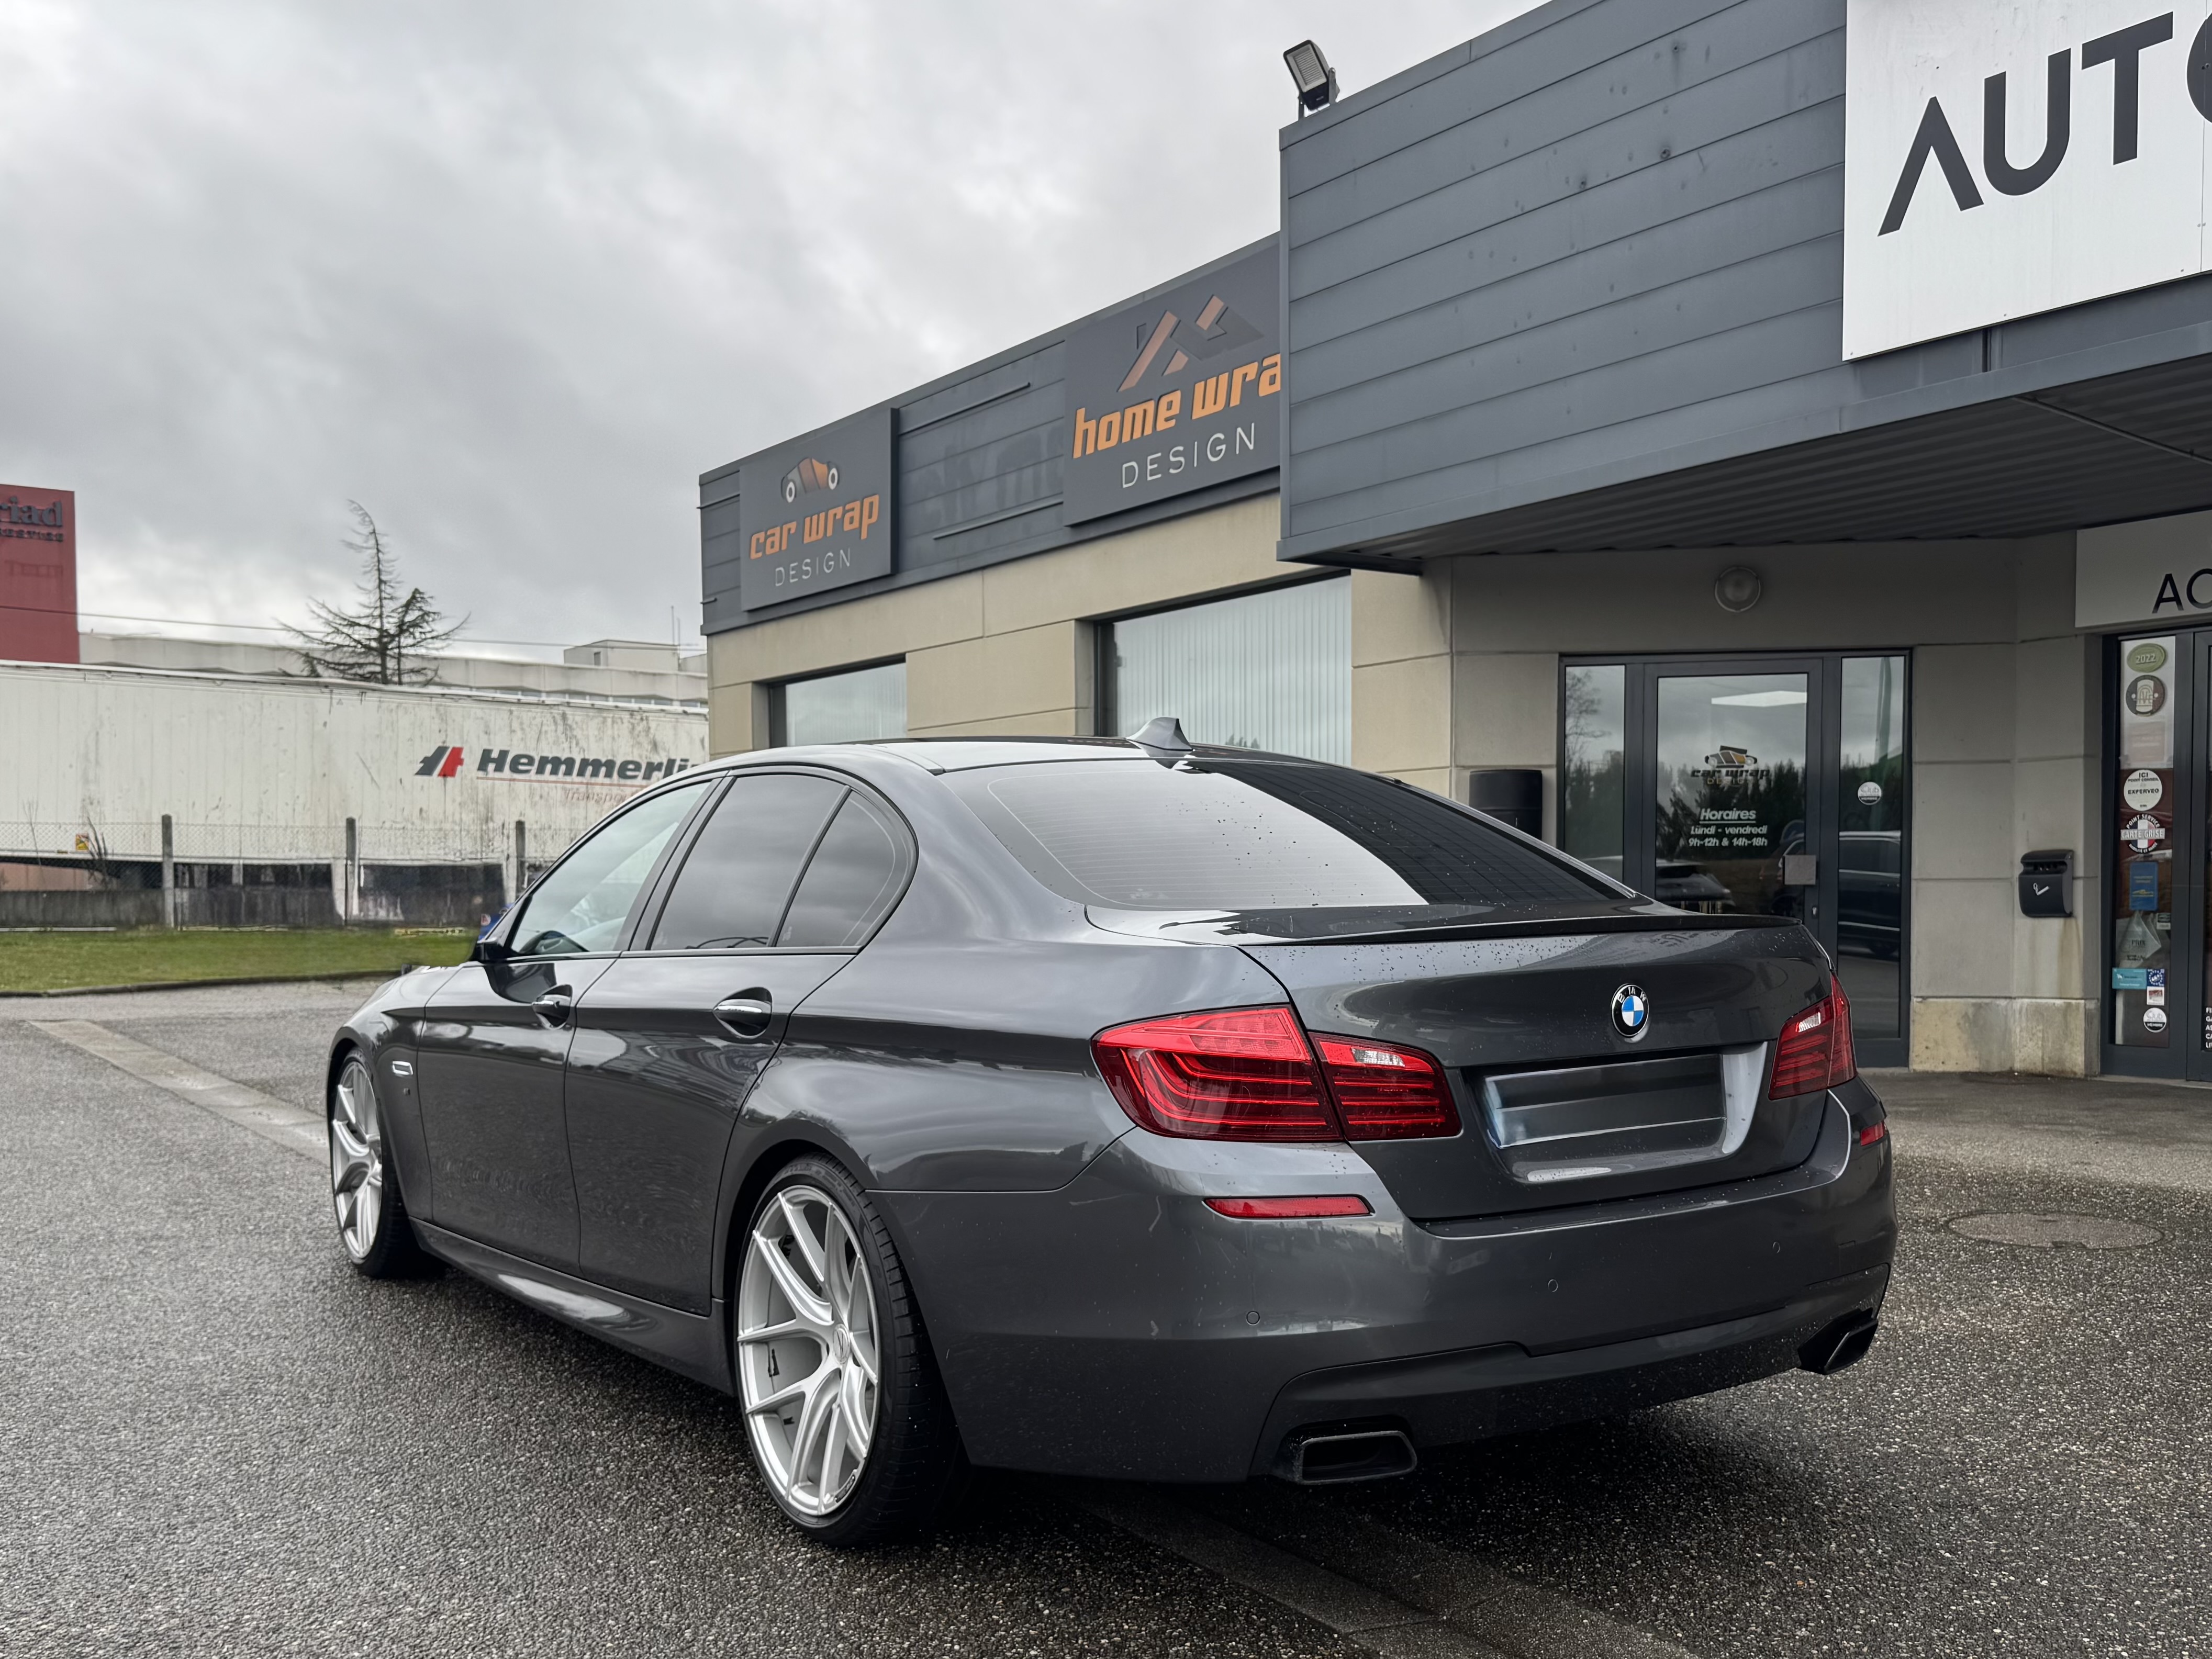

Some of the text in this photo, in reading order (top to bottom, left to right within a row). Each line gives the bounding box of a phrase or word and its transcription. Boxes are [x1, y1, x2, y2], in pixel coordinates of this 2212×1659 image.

[1878, 11, 2212, 237] AUT
[1073, 390, 1181, 459] home
[1122, 422, 1255, 488] DESIGN
[750, 494, 880, 560] car wrap
[775, 547, 851, 587] DESIGN
[2135, 654, 2157, 664] 2022
[477, 748, 699, 780] Hemmerli
[1700, 808, 1757, 821] Horaires
[2126, 815, 2140, 830] POINT
[1725, 825, 1768, 834] vendredi
[2120, 830, 2164, 838] CARTE GRISE
[1688, 837, 1768, 847] 9h-12h & 14h-18h
[1616, 986, 1647, 1004] BMW
